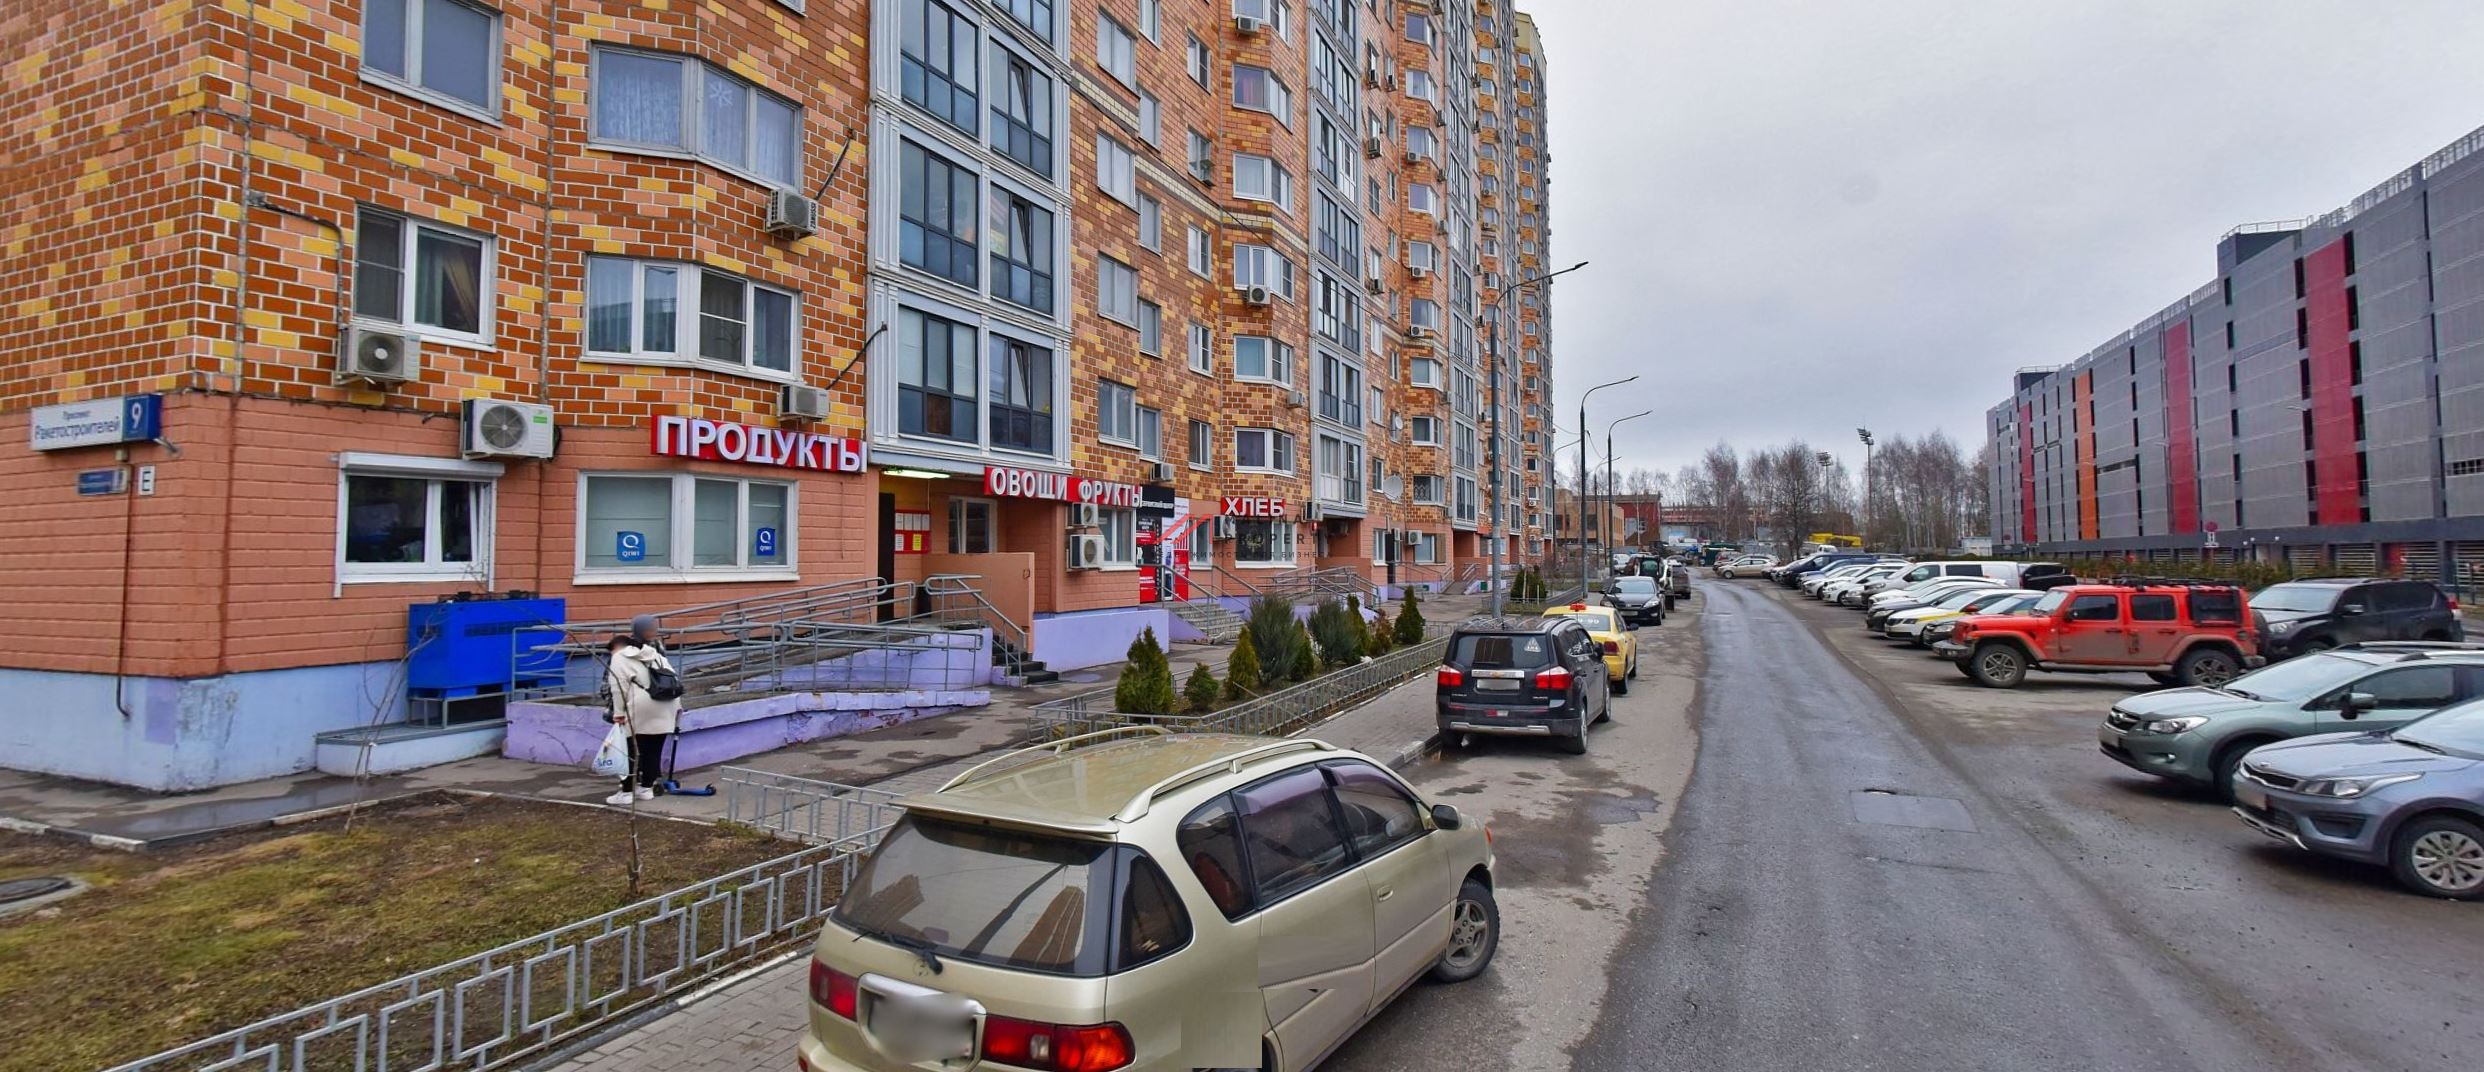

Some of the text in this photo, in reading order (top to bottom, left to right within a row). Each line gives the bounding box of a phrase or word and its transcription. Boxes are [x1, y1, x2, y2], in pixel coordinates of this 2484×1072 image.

[35, 416, 119, 440] Ракетостроителей
[131, 401, 143, 429] 9
[656, 415, 868, 473] ПРОДУКТЫ
[989, 466, 1143, 507] ОВОЩИ ФРУКТЫ
[1224, 496, 1285, 517] ХЛЕБ
